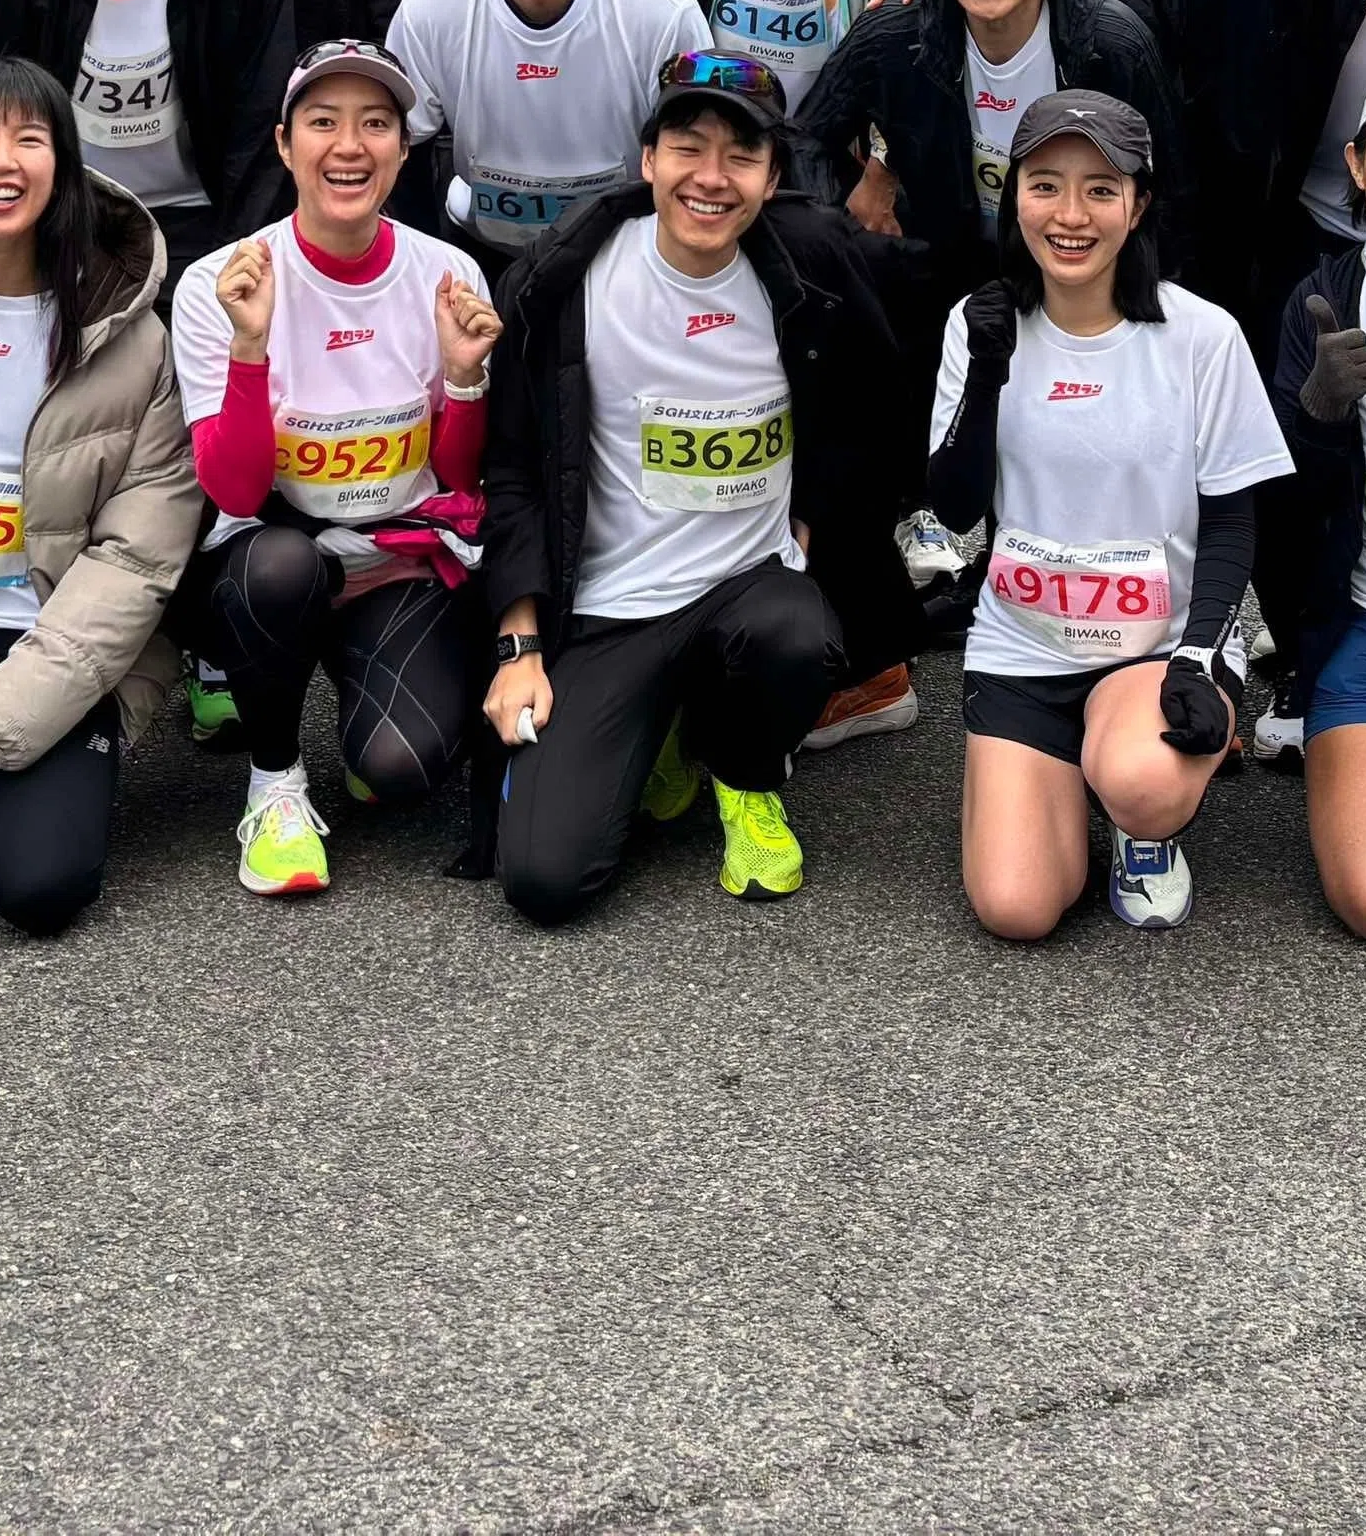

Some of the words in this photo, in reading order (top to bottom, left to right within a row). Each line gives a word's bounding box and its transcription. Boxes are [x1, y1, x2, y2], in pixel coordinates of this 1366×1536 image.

[749, 44, 795, 60] BIWAKO
[80, 67, 173, 113] 7347
[110, 119, 161, 135] BIWAKO
[337, 486, 390, 503] BIWAKO
[716, 477, 767, 496] BIWAKO
[1064, 625, 1122, 641] BIWAKO
